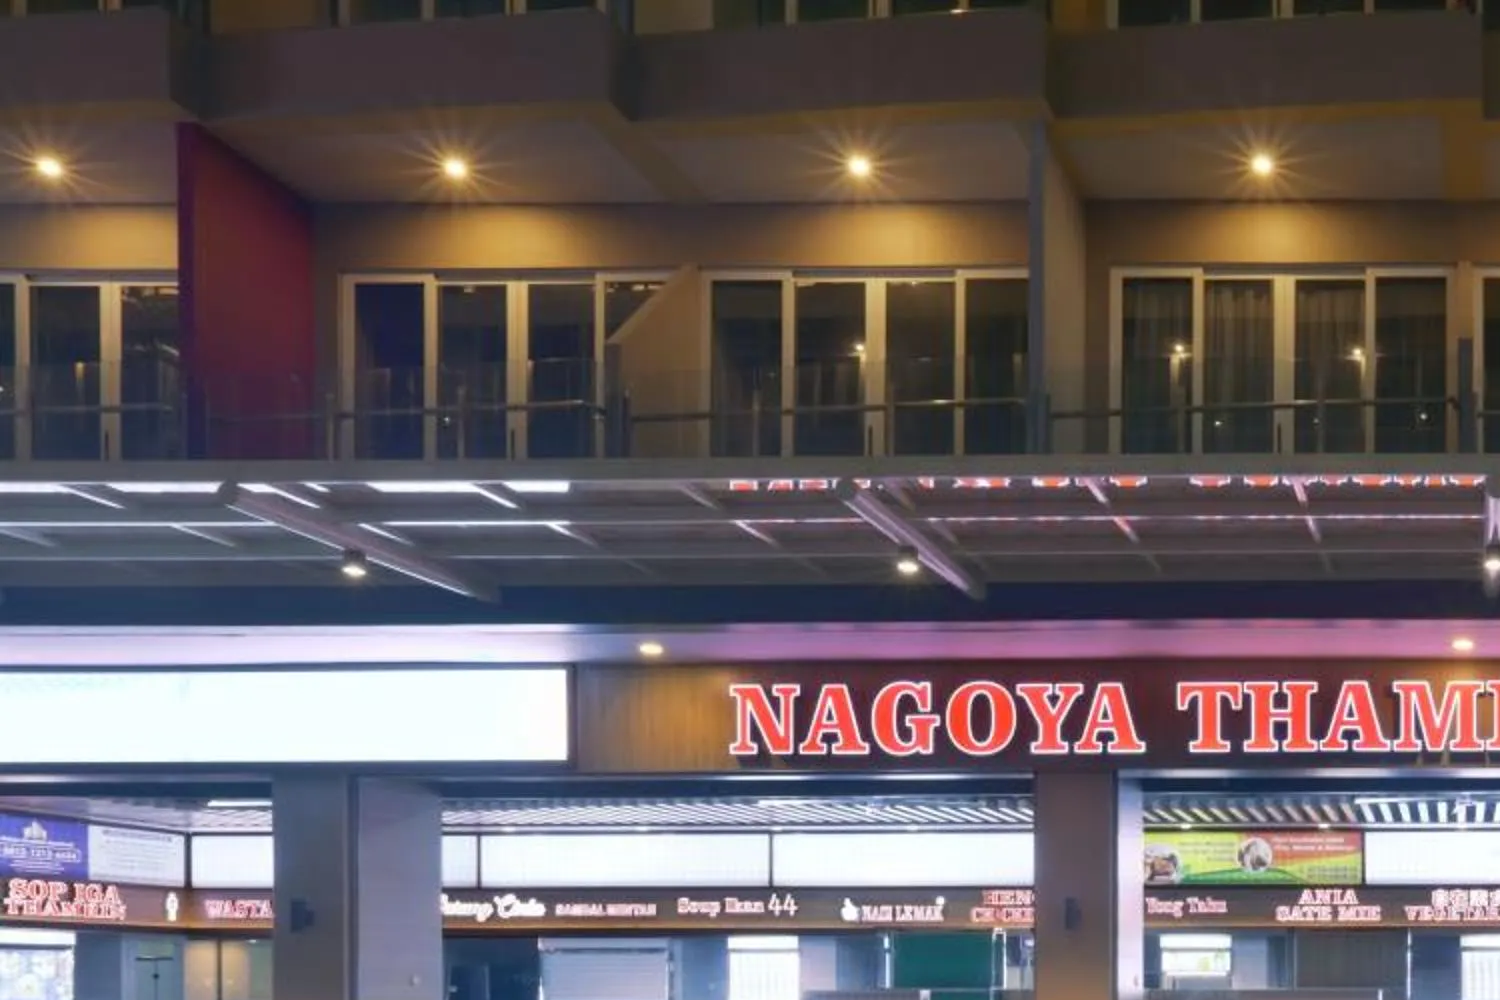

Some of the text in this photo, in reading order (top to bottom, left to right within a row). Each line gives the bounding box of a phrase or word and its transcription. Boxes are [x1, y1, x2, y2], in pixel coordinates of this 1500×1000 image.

[728, 680, 1147, 757] NAGOYA
[9, 878, 121, 904] SOP IGA
[677, 897, 721, 918] Soup
[767, 893, 798, 917] 44
[1275, 905, 1332, 921] SATE
